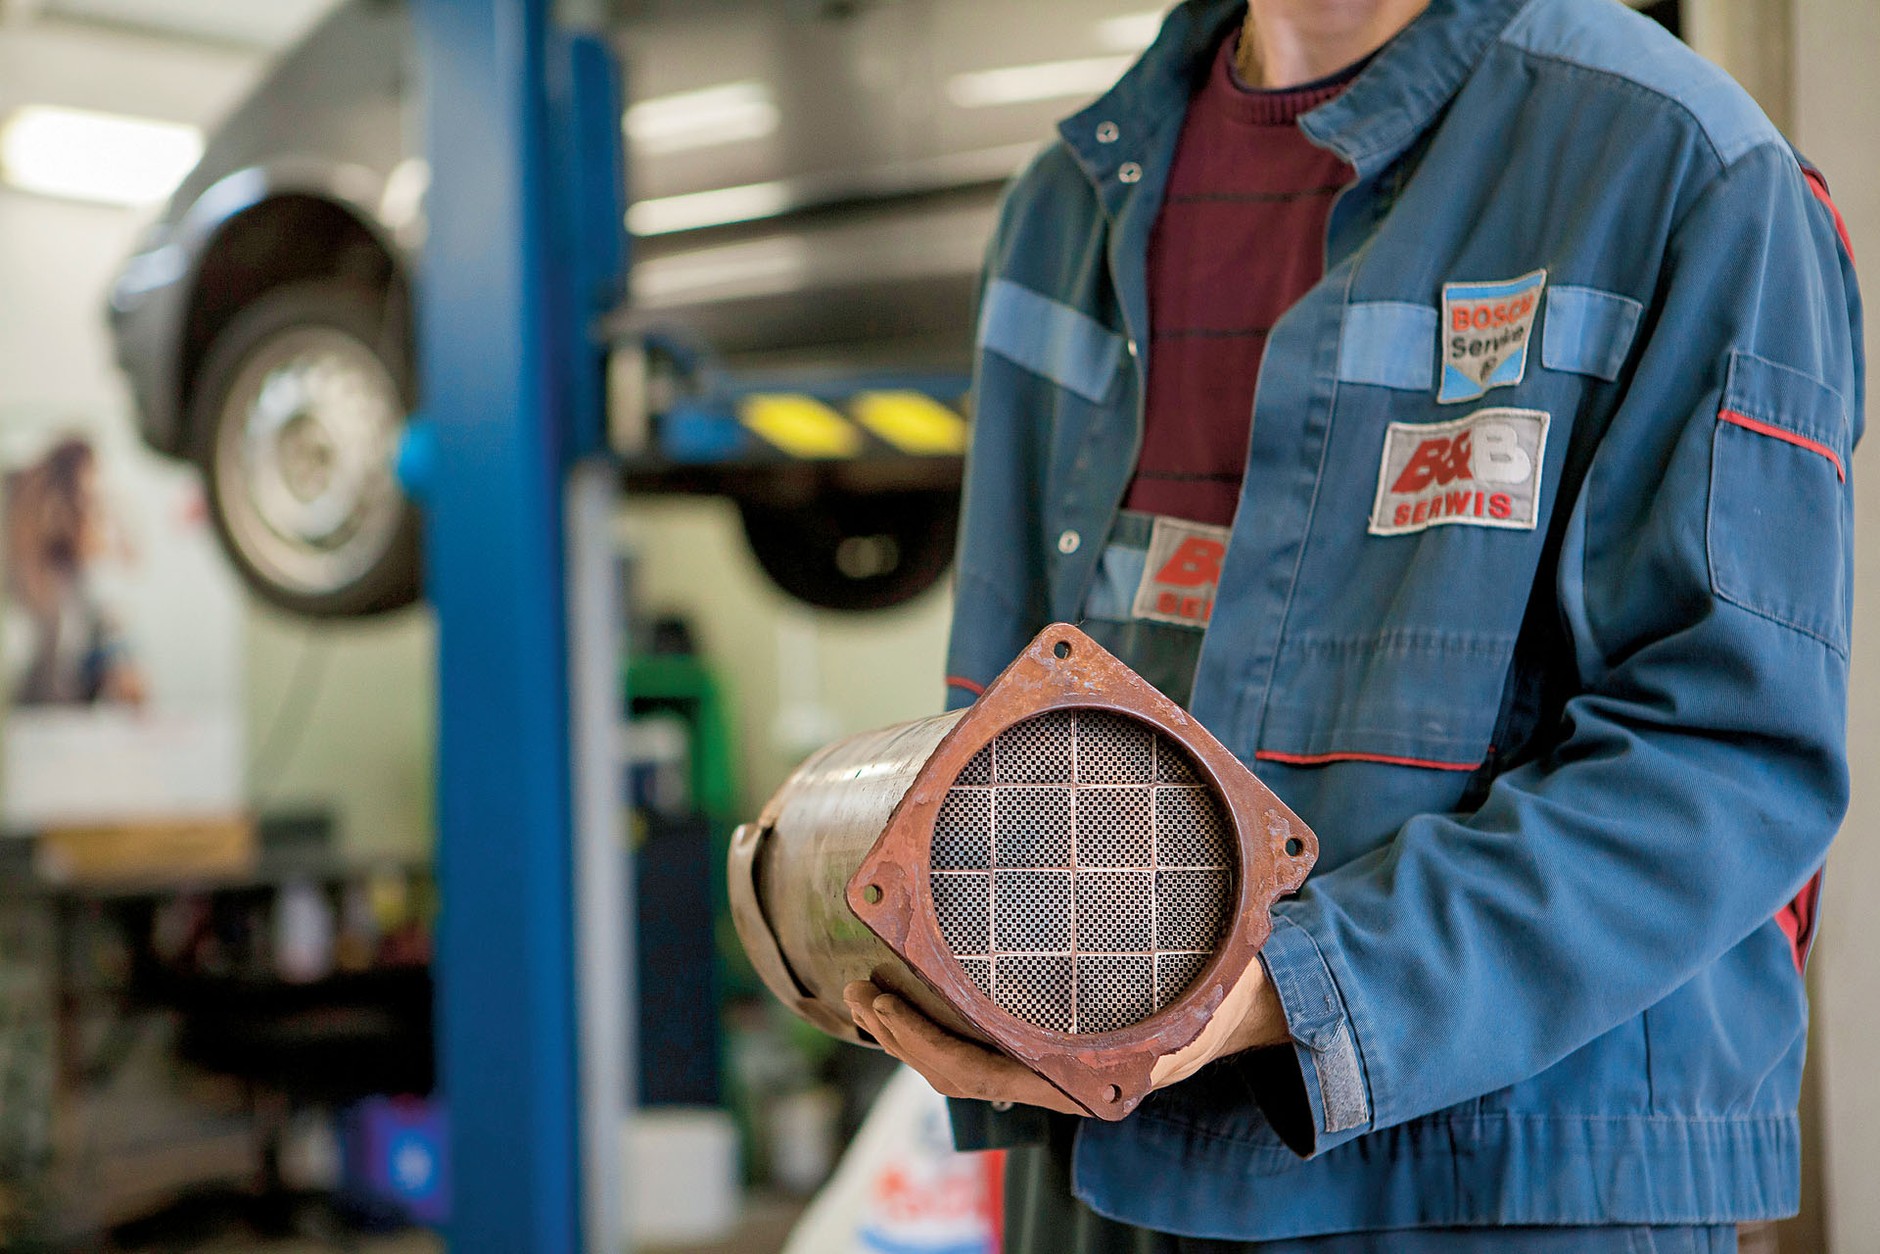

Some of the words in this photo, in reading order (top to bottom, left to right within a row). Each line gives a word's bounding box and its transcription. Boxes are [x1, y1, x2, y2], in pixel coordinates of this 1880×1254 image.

[1452, 293, 1534, 332] BOSCH
[1391, 423, 1532, 495] B&B
[1394, 491, 1512, 527] SERWIS
